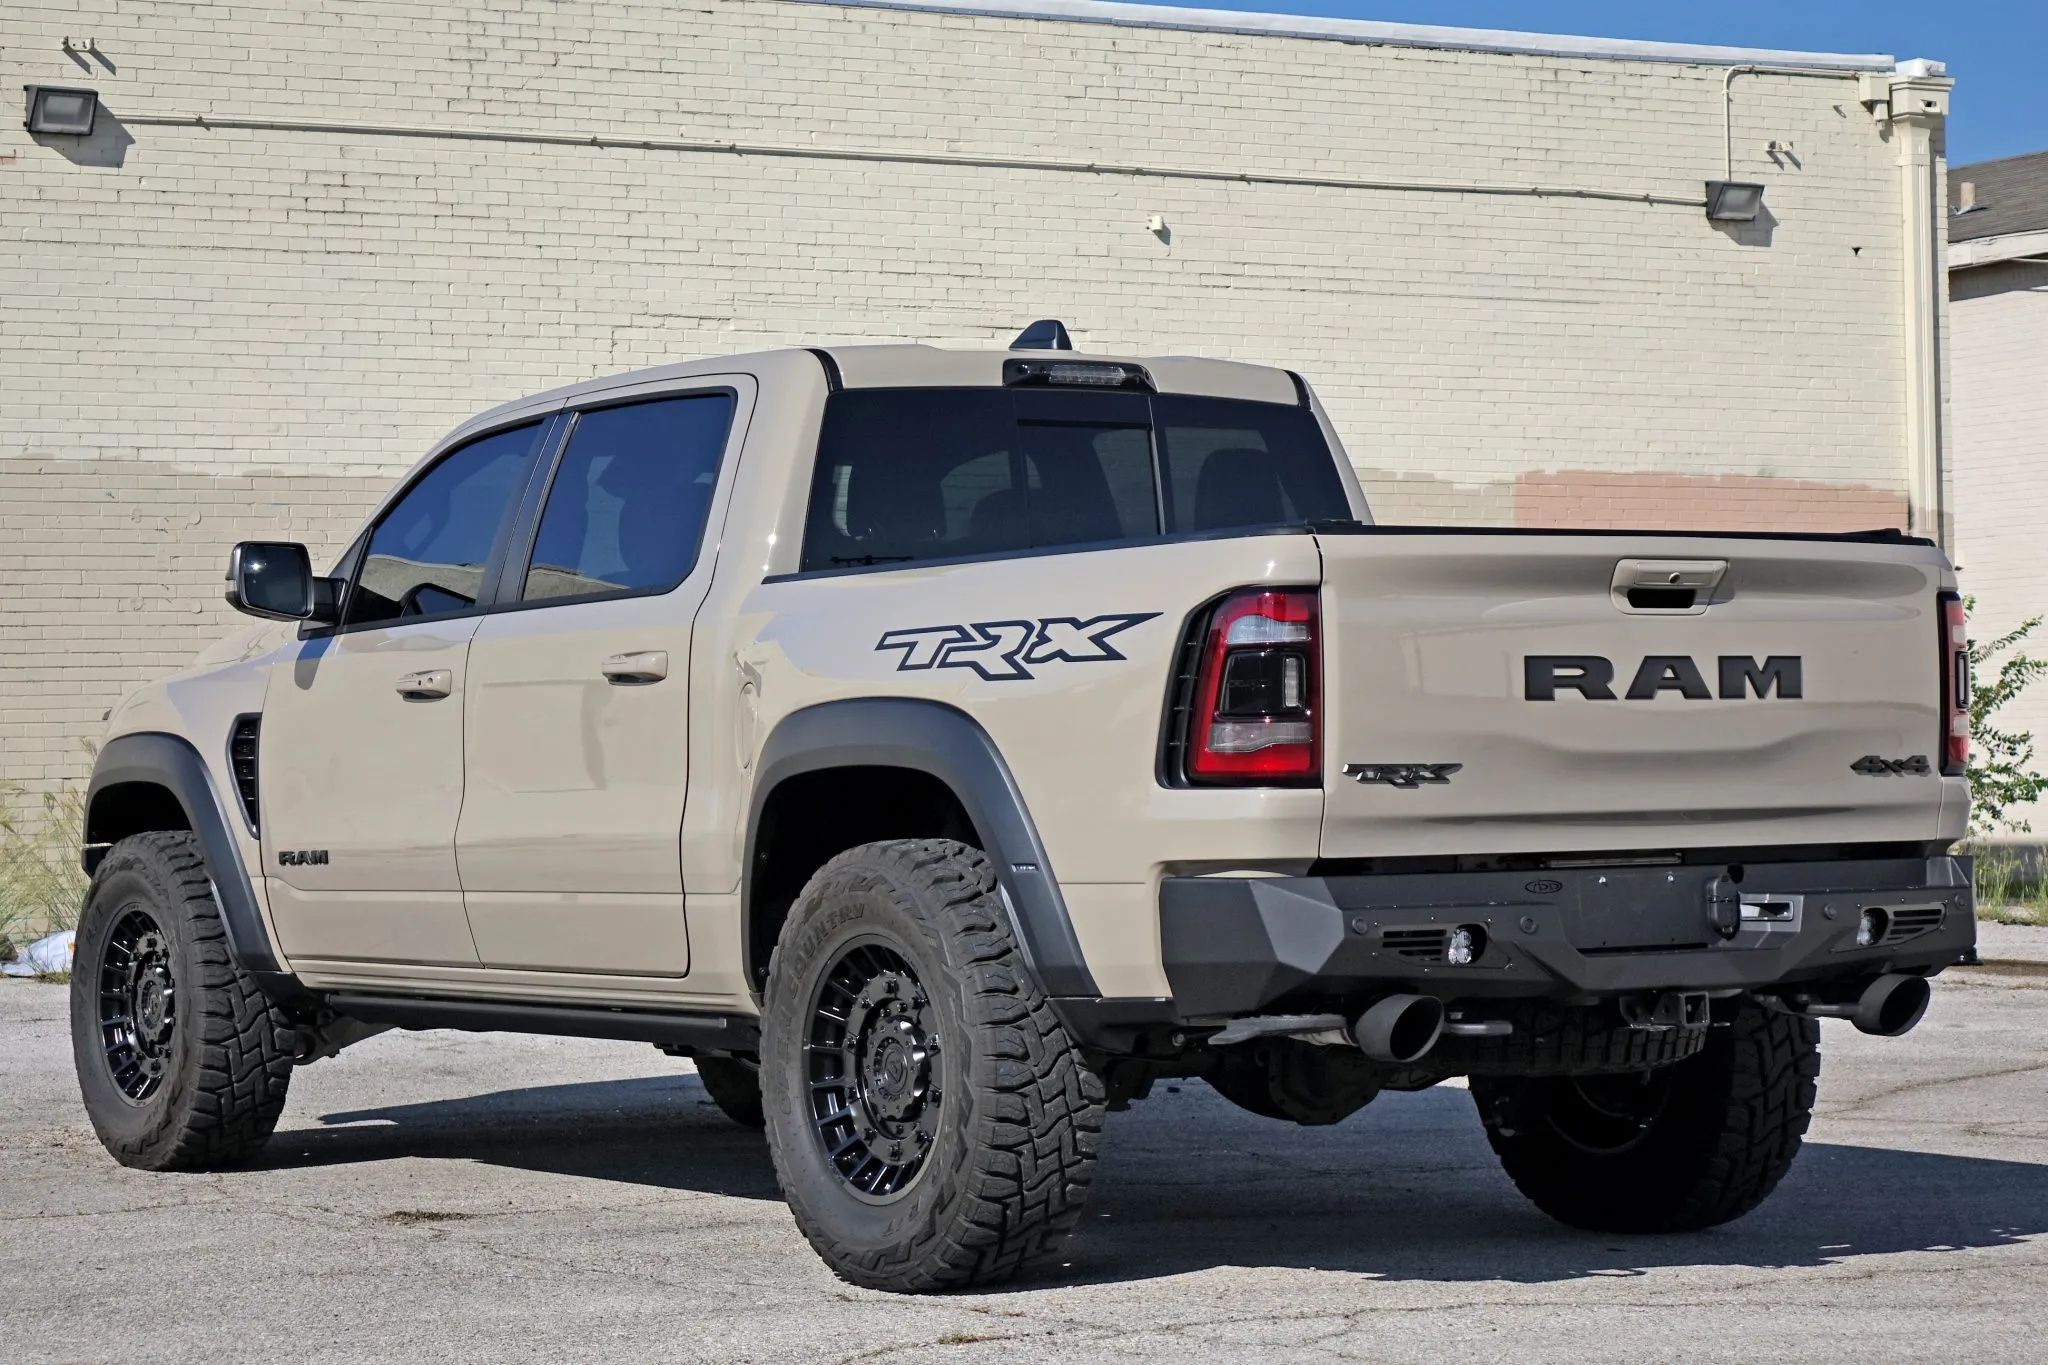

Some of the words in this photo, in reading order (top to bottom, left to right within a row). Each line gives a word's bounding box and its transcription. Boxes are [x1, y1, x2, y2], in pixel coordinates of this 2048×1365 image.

[873, 612, 1164, 681] TRX
[1524, 655, 1803, 701] RAM
[279, 850, 329, 866] RAM
[788, 902, 865, 999] COUNTRY
